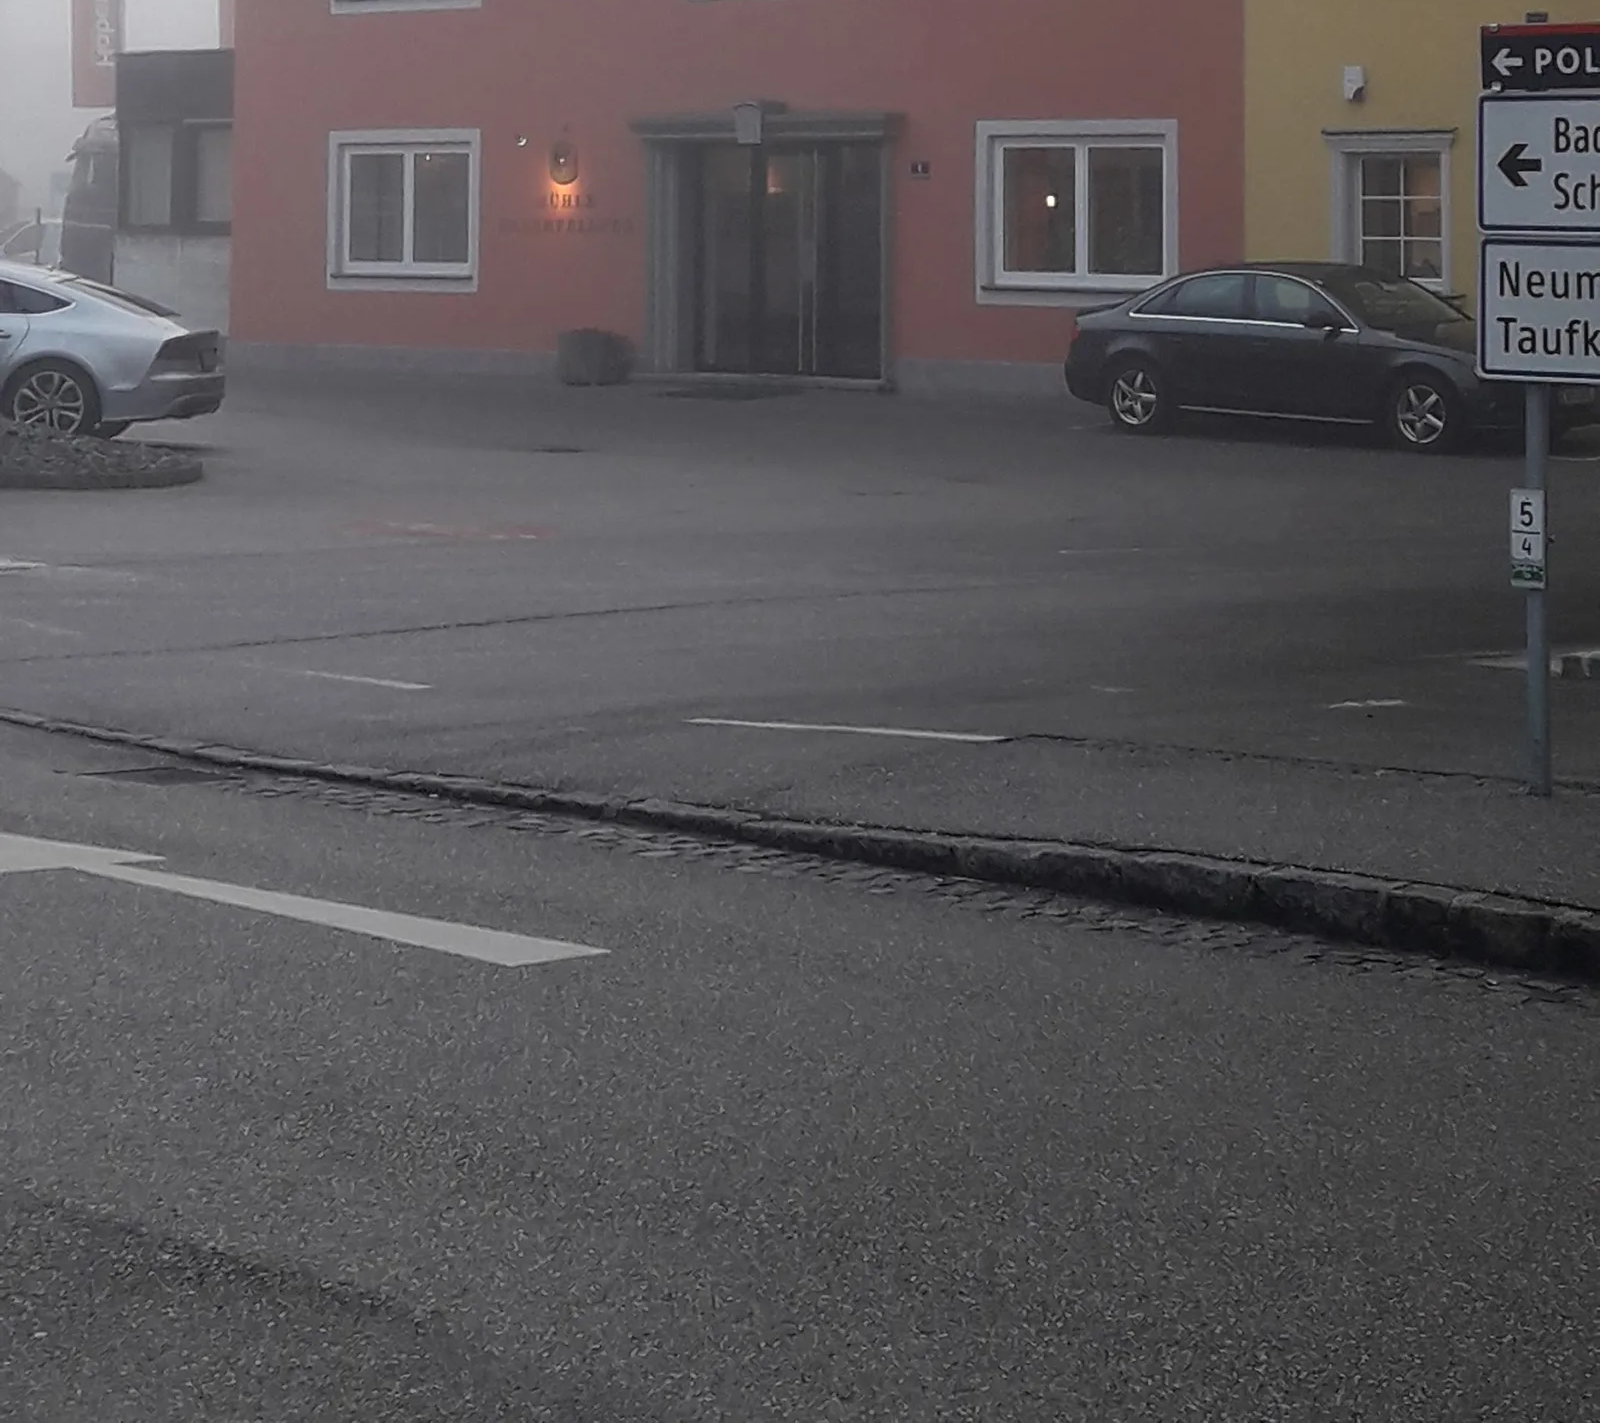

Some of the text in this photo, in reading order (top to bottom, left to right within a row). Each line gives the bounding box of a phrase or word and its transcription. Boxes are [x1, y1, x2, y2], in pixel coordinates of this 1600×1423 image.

[1535, 46, 1600, 75] POL
[1553, 172, 1600, 211] Sch
[1499, 261, 1600, 300] Neum
[1496, 316, 1600, 357] Taufk
[1520, 501, 1534, 527] 5
[1521, 537, 1532, 556] 4
